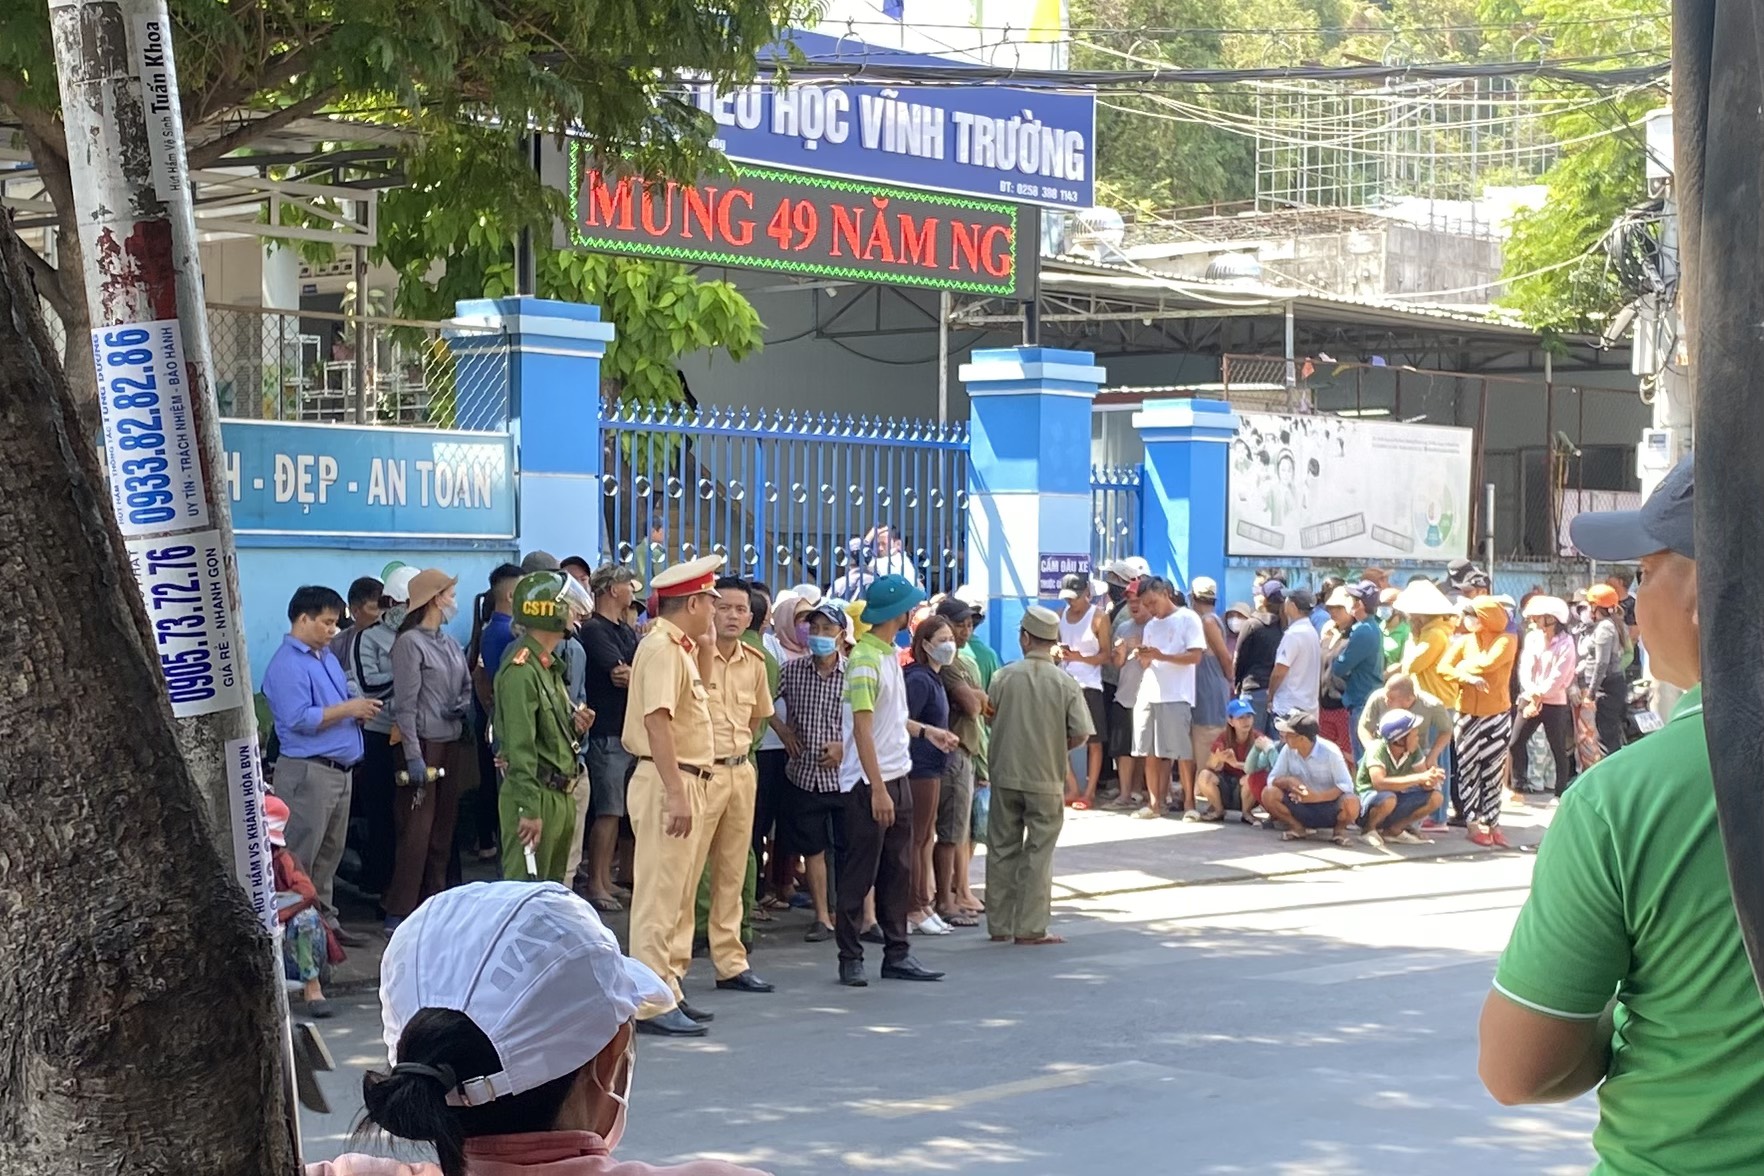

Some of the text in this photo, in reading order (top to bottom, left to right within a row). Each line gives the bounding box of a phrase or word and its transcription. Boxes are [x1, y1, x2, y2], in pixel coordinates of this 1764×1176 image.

[144, 22, 164, 67] Khoa
[147, 74, 170, 114] Tuấn
[161, 116, 173, 136] Sinh
[771, 85, 849, 150] HỌC
[857, 89, 944, 160] VĨNH
[952, 109, 1085, 181] TRƯỜNG
[766, 198, 818, 251] 49
[829, 196, 940, 268] NĂM
[161, 327, 176, 359] HÀNH
[163, 361, 180, 385] BẢO
[104, 329, 175, 524] 0933.82.82.86
[170, 395, 187, 431] NHIỆM
[176, 434, 192, 472] TRÁCH
[182, 481, 196, 499] TÍN
[274, 453, 338, 514] ĐẸP
[367, 457, 407, 506] AN
[187, 502, 199, 517] UY
[205, 548, 220, 578] GỌN
[1078, 561, 1089, 573] XE
[210, 582, 226, 629] NHANH
[522, 601, 556, 617] CSTT
[146, 546, 215, 703] 0905.73.72.76
[214, 641, 231, 660] RẺ
[219, 663, 234, 688] GIÁ
[239, 745, 251, 769] BVN
[240, 772, 253, 796] HÒA
[243, 800, 259, 840] KHÁNH
[248, 842, 260, 859] VS
